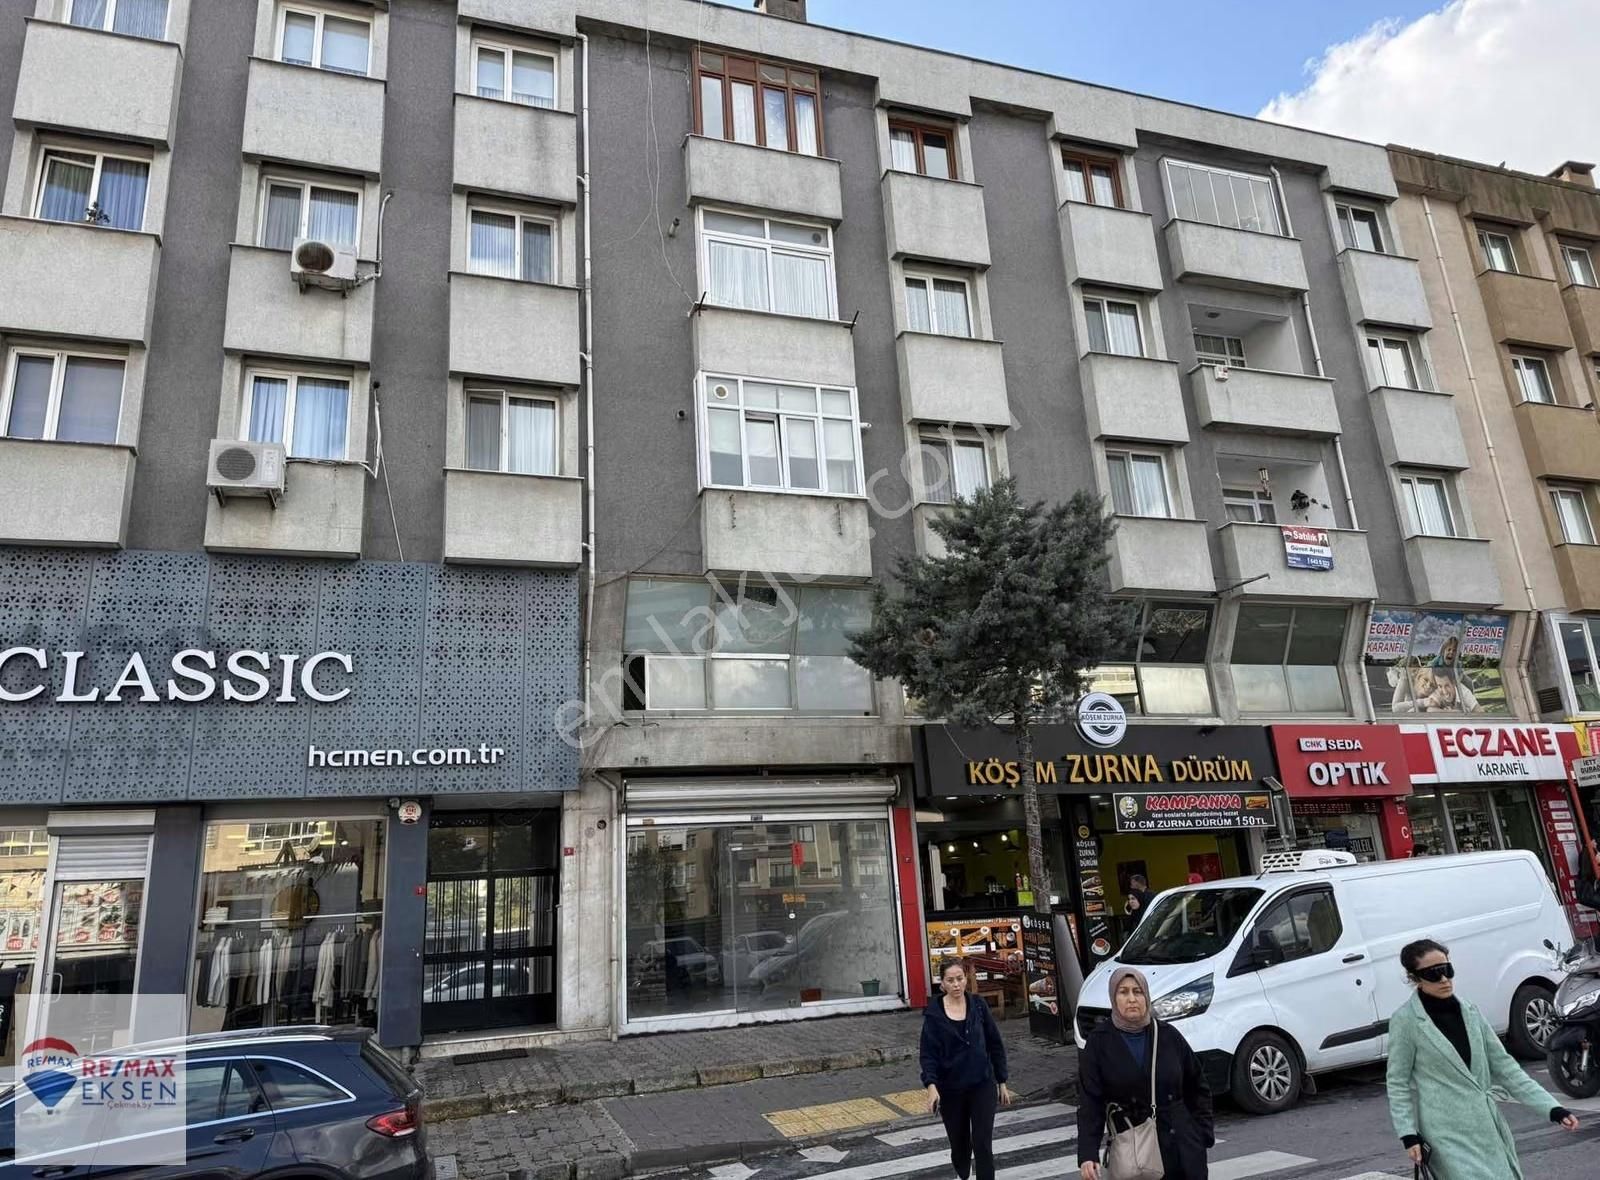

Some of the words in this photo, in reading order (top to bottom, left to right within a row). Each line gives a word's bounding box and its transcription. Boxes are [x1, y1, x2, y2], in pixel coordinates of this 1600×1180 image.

[1369, 623, 1411, 635] ECZANE
[1466, 626, 1504, 638] ECZANE
[1367, 640, 1406, 653] KARANFİL
[0, 647, 354, 702] CLASSIC
[1304, 739, 1323, 749] CNK
[1327, 739, 1363, 751] SEDA
[1436, 727, 1557, 758] ECZANE
[308, 743, 505, 768] hcmen.com.tr
[968, 757, 1058, 789] KÖŞM
[1066, 754, 1164, 783] ZURNA
[1172, 755, 1252, 782] DÜRÜM
[1477, 759, 1529, 776] KARANFİL
[1146, 794, 1241, 811] KAMPANYA
[1124, 821, 1136, 829] 70
[1139, 820, 1154, 828] CM
[1157, 820, 1194, 828] ZURNA
[1195, 817, 1232, 827] DÜRÜM
